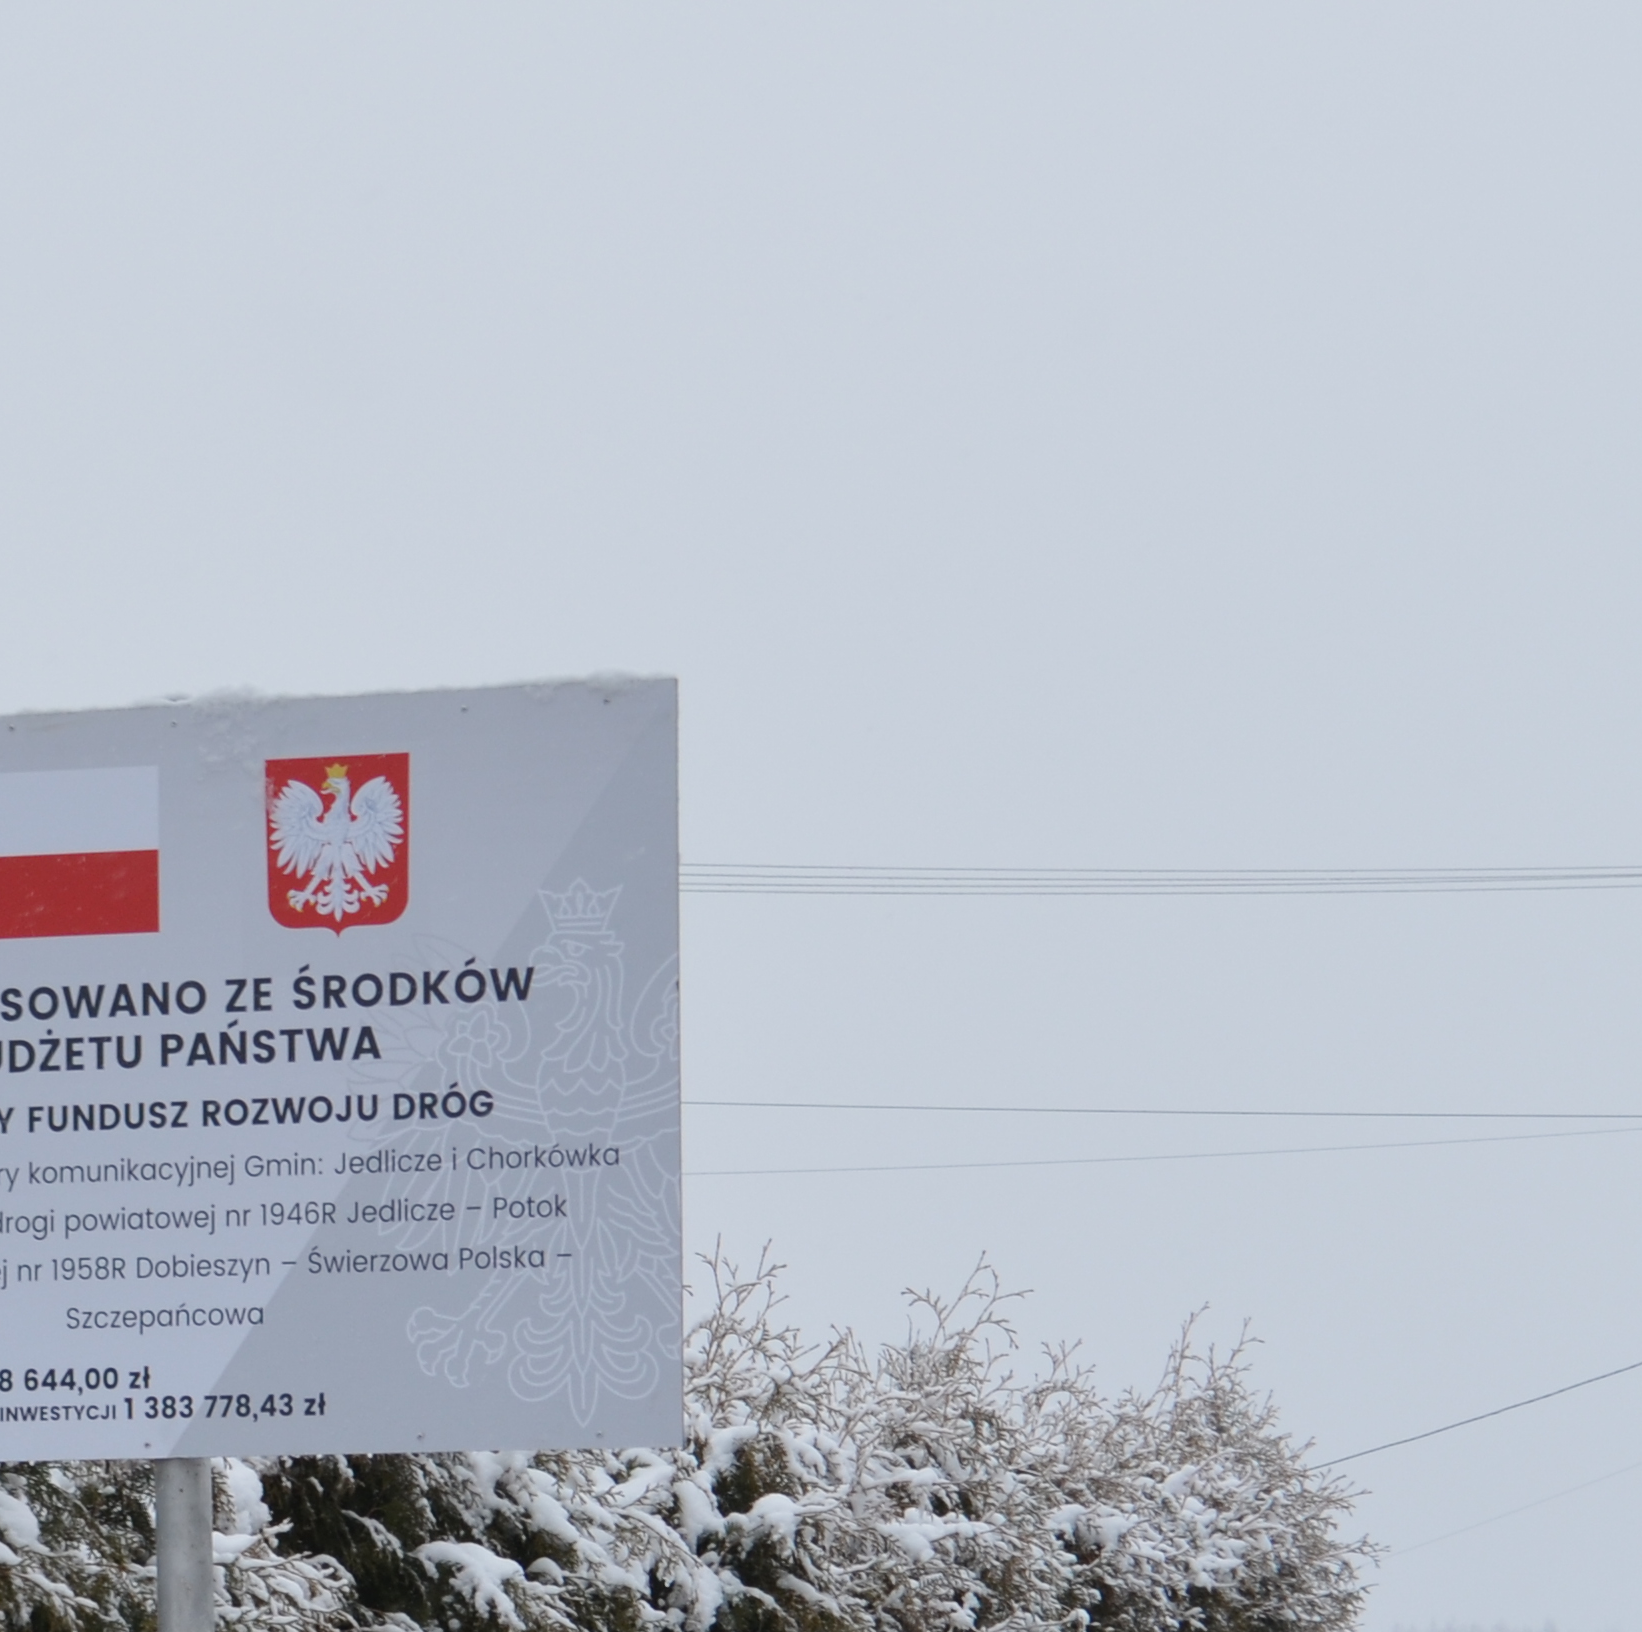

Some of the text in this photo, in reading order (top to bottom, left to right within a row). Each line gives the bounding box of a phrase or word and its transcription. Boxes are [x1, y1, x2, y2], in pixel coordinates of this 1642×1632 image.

[224, 976, 273, 1014] ZE
[292, 956, 535, 1011] ŚRODKÓW
[159, 1018, 383, 1068] PAŃSTWA
[27, 1100, 189, 1134] FUNDUSZ
[201, 1093, 379, 1128] ROZWOJU
[392, 1081, 495, 1121] DRÓG
[28, 1153, 235, 1188] komunikacyjnej
[244, 1151, 323, 1178] Gmin:
[334, 1148, 443, 1175] Jedlicze
[452, 1146, 457, 1171] i
[466, 1142, 620, 1171] Chorkówka
[64, 1203, 216, 1240] powiatowej
[225, 1208, 252, 1228] nr
[260, 1200, 337, 1226] 1946R
[346, 1197, 456, 1224] Jedlicze
[493, 1193, 568, 1219] Potok
[17, 1263, 43, 1282] nr
[51, 1255, 126, 1282] 1958R
[136, 1253, 271, 1284] Dobieszyn
[307, 1245, 449, 1275] Świerzowa
[459, 1245, 545, 1270] Polska
[66, 1302, 264, 1336] Szczepańcowa
[23, 1366, 120, 1397] 644,00
[128, 1365, 152, 1390] zł
[0, 1404, 117, 1423] INWESTYCJI
[123, 1396, 134, 1421] 1
[143, 1394, 194, 1420] 383
[203, 1392, 294, 1423] 778,43
[303, 1391, 327, 1417] zł
